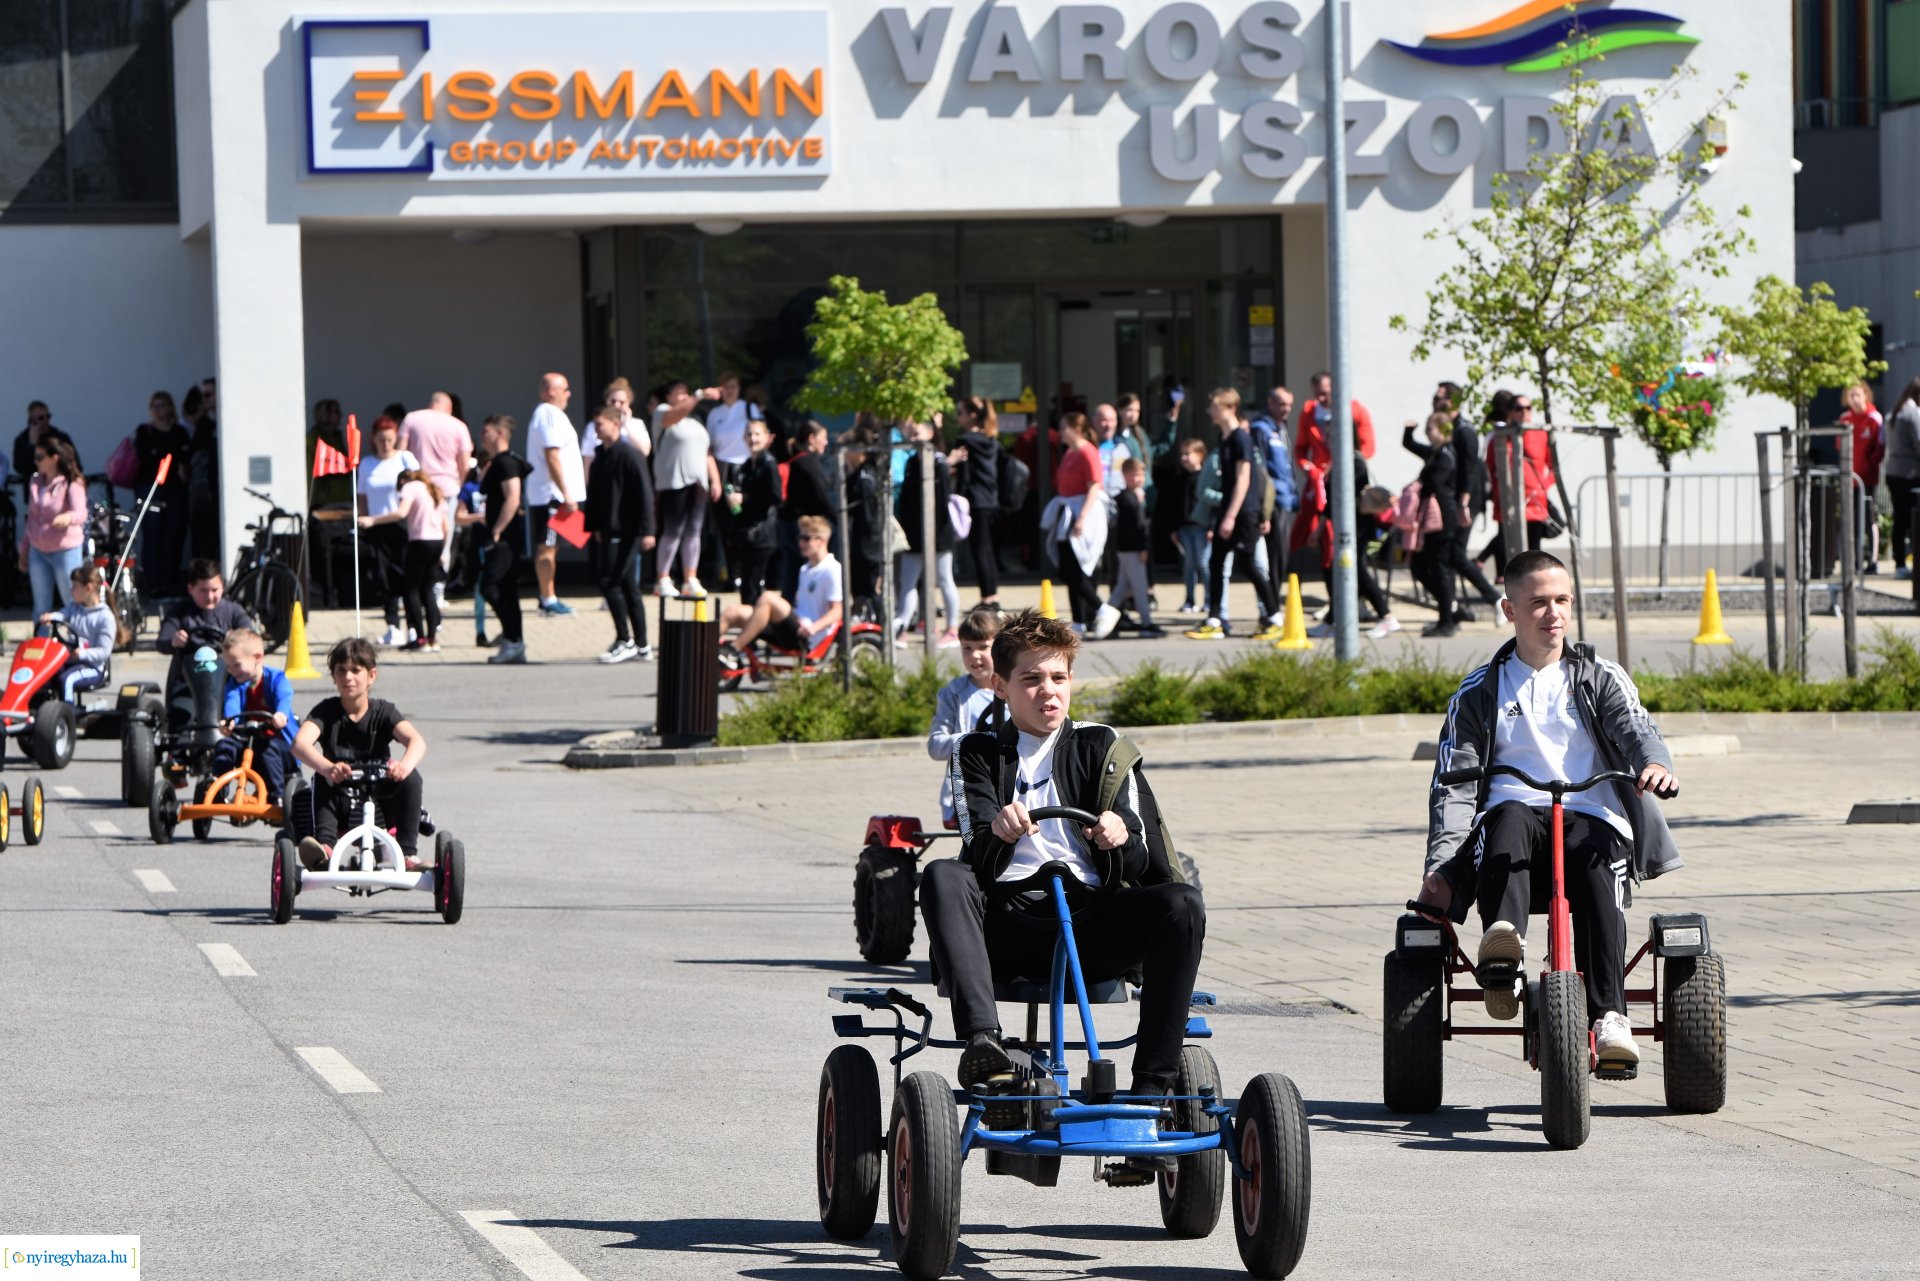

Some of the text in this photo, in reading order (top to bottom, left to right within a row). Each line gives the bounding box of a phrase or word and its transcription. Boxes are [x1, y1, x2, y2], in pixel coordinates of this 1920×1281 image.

[353, 68, 823, 122] EISSMANN
[449, 137, 823, 163] GROUP AUTOMOTIVE
[1149, 94, 1658, 182] USZODA
